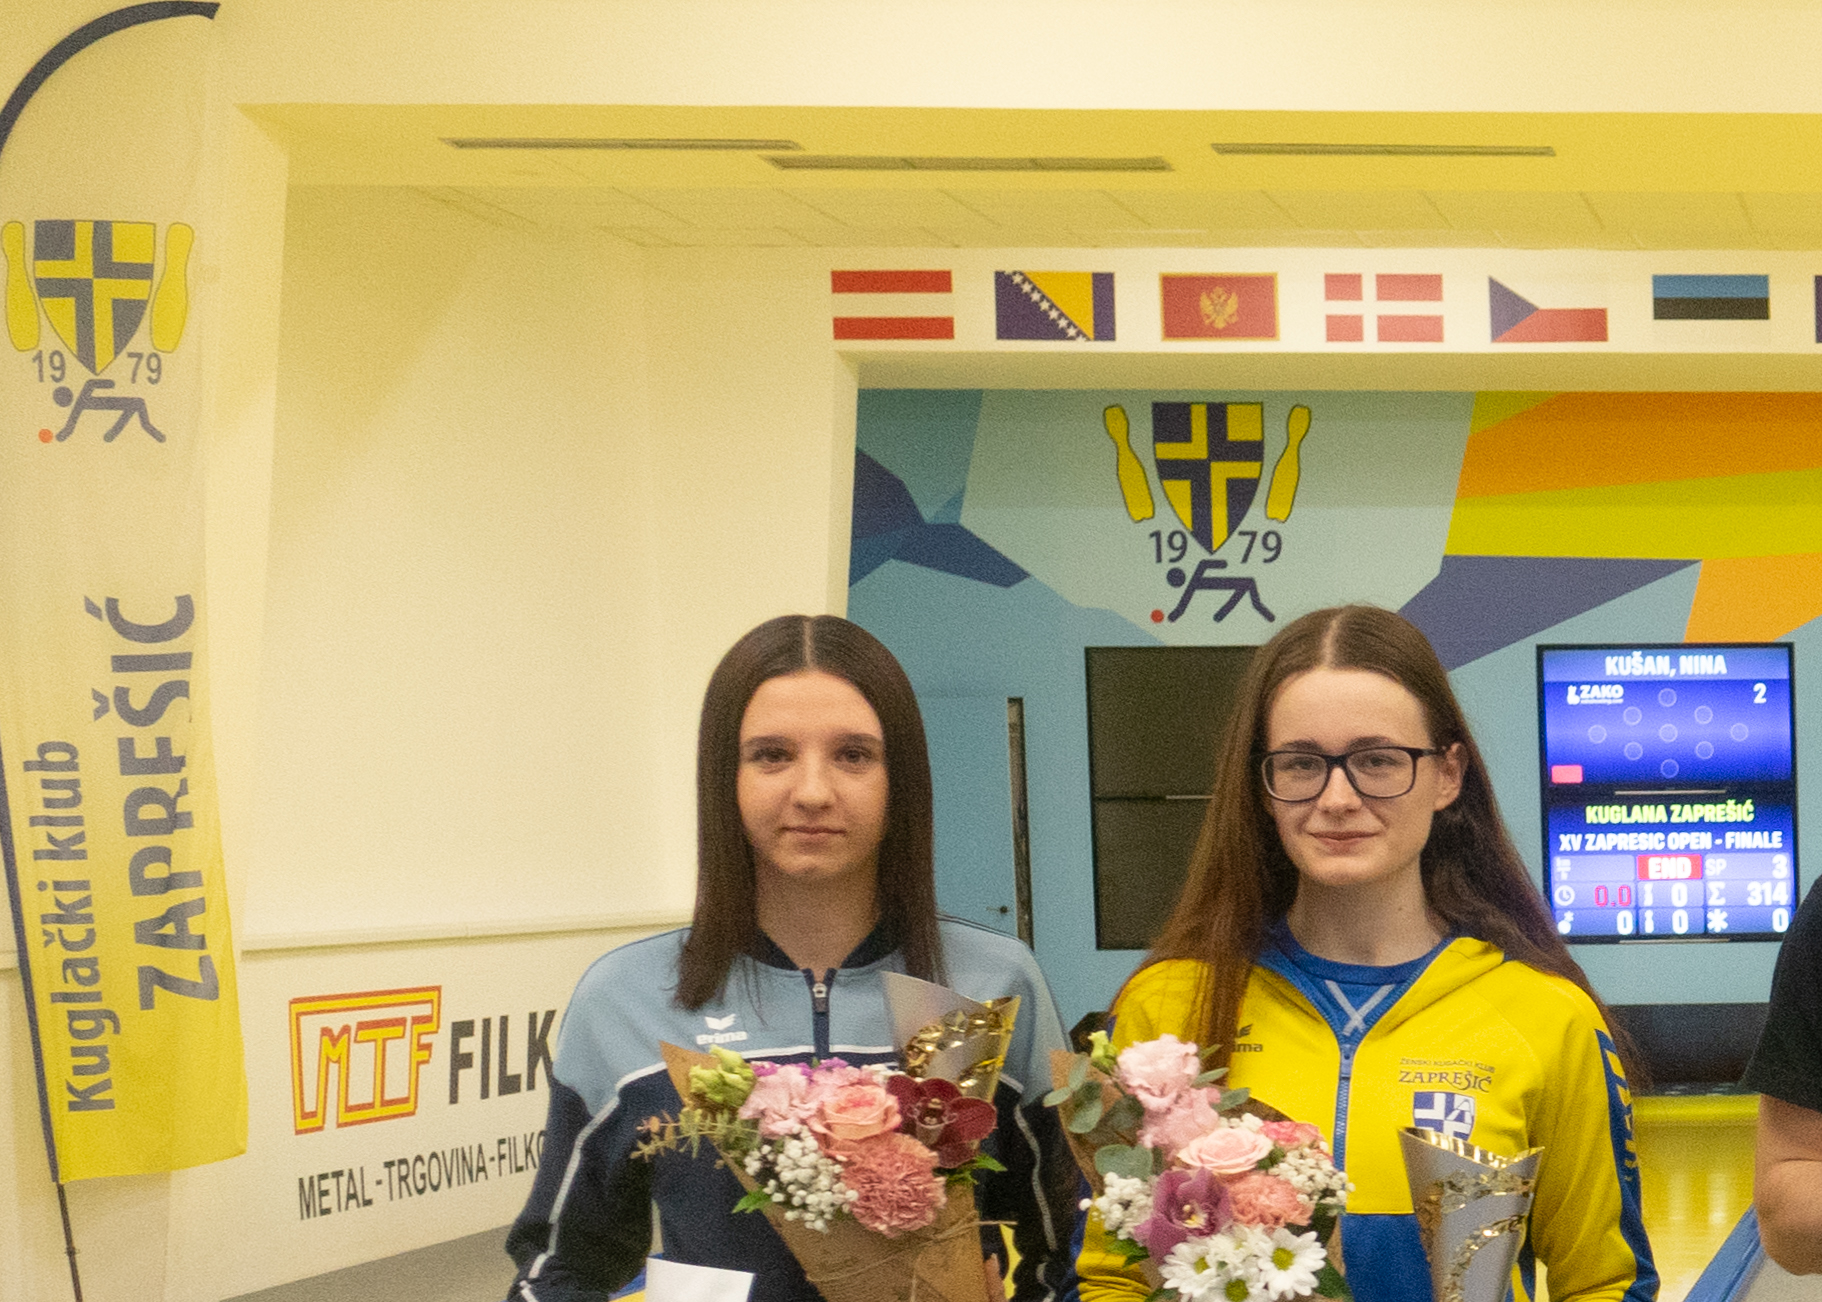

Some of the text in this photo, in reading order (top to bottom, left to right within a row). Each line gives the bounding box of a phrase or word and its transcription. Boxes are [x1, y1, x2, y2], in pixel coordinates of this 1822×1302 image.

[32, 350, 162, 385] 19 79
[1149, 530, 1283, 564] 19 79
[1605, 651, 1727, 677] KUŠAN, NINA
[1580, 684, 1624, 698] ZAKO
[1753, 683, 1767, 703] 2
[84, 594, 220, 1010] ZAPREŠIĆ
[1585, 799, 1754, 824] KUGLANA ZAPREŠIĆ
[1559, 834, 1582, 851] XV
[1584, 833, 1665, 851] ZAPRESIC
[1667, 832, 1712, 850] OPEN
[1725, 831, 1783, 849] FINALE
[1648, 857, 1692, 879] END
[1705, 854, 1788, 879] SP 3
[1594, 885, 1631, 907] 0.0
[1671, 882, 1688, 907] 0
[1747, 881, 1789, 906] 314
[24, 740, 121, 1113] Kuglački klub
[1617, 910, 1633, 935] 0
[1672, 909, 1689, 935] 0
[1772, 908, 1789, 933] 0
[696, 1031, 748, 1045] erima
[289, 985, 442, 1135] MTF
[449, 1010, 557, 1105] FILK
[1399, 1070, 1492, 1093] ZAPREŠIĆ
